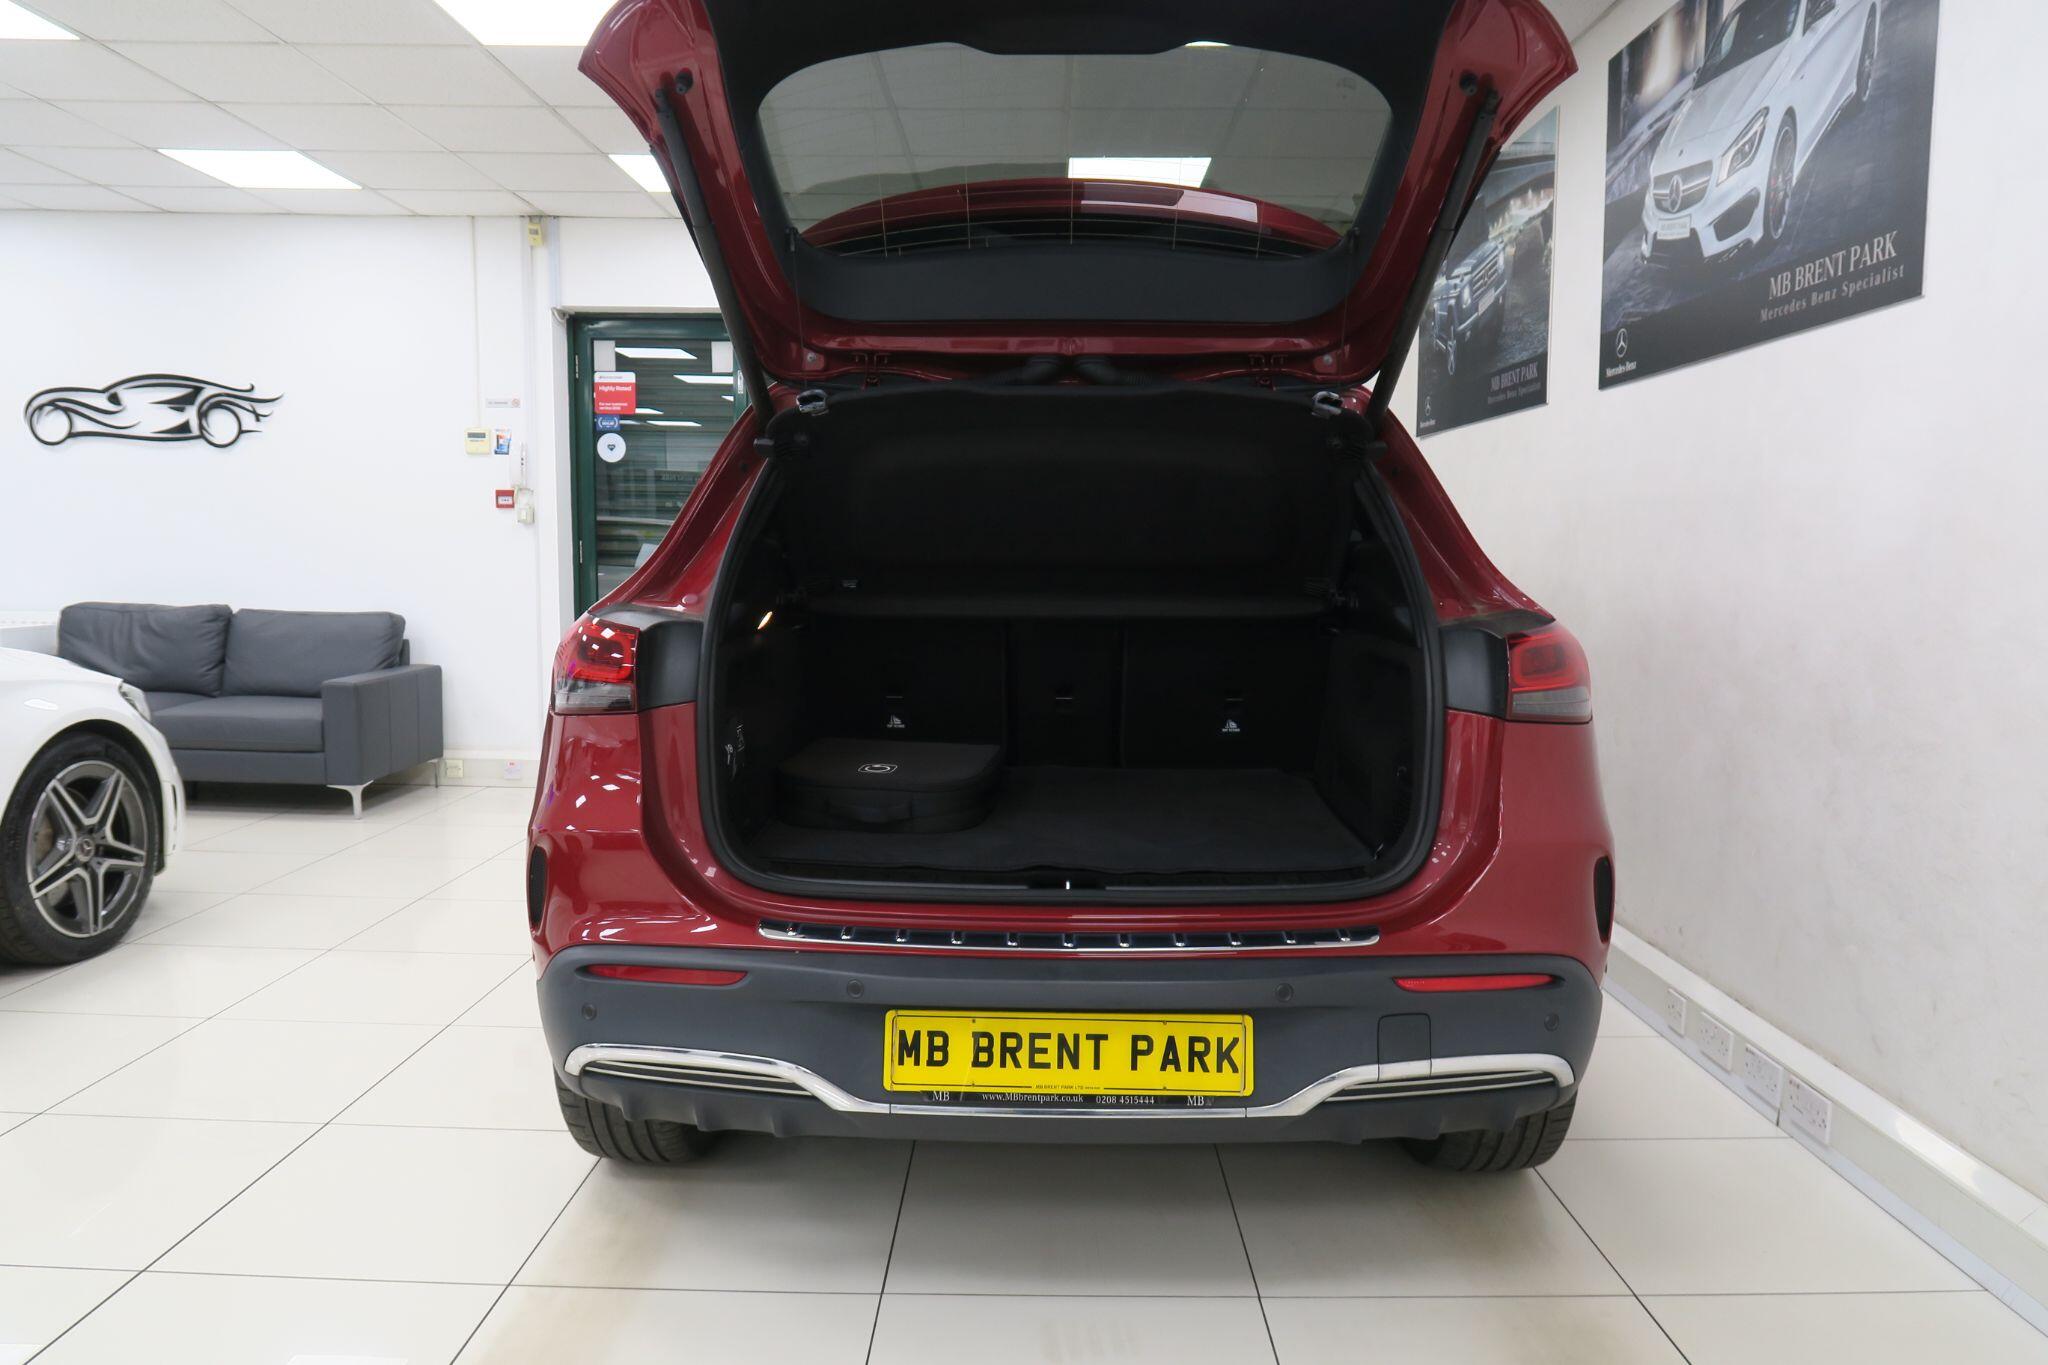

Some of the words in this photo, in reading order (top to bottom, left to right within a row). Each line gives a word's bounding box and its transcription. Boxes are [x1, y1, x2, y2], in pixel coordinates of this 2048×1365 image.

[1769, 271, 1791, 300] MB
[1795, 250, 1847, 291] BRENT
[1850, 230, 1898, 272] PARK
[1760, 297, 1806, 322] Mercedes
[1811, 287, 1837, 306] Benz
[1842, 264, 1904, 297] Specialist
[1521, 361, 1538, 382] PARK
[898, 1030, 949, 1067] MB
[971, 1032, 1109, 1071] BRENT
[1130, 1035, 1240, 1074] PARK
[932, 1090, 951, 1102] MB
[981, 1092, 1084, 1104] www.MBbrentpark.co.uk
[1096, 1095, 1117, 1105] 0208
[1119, 1095, 1155, 1106] 4515444
[1186, 1095, 1205, 1107] MB
